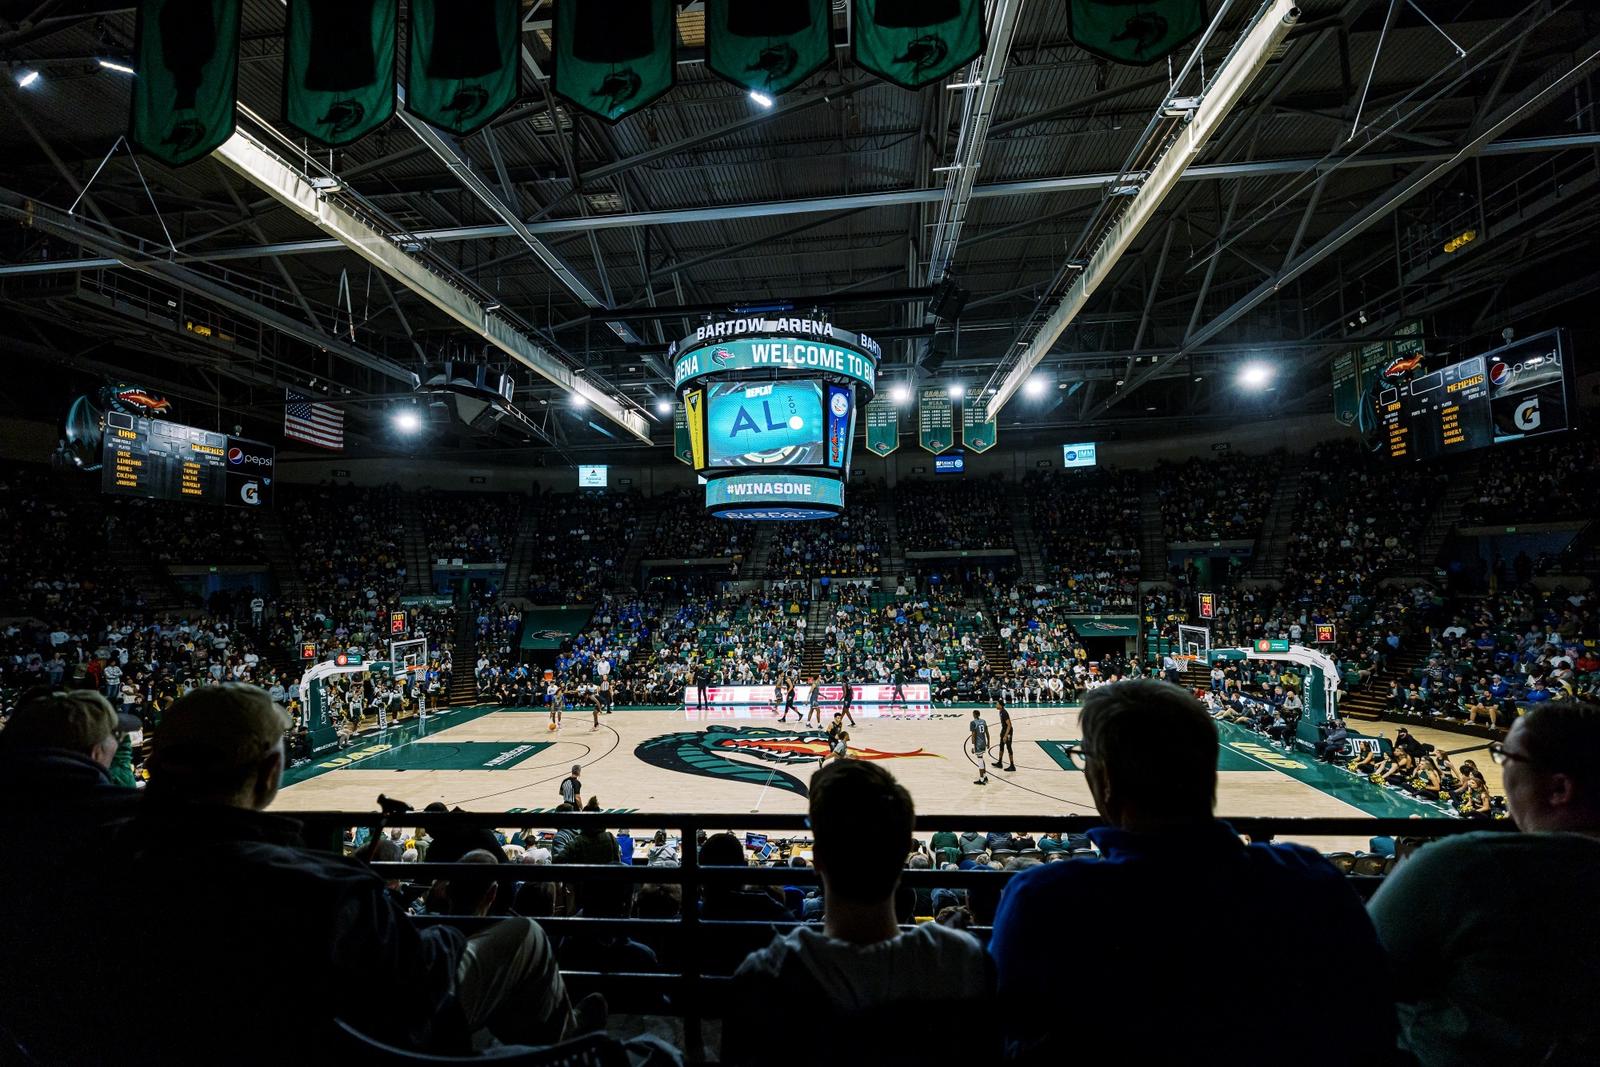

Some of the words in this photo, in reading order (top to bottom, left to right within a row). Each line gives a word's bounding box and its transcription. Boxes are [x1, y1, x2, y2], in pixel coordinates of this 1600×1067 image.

[697, 318, 764, 340] BARTOW
[776, 318, 834, 337] ARENA
[752, 343, 844, 371] WELCOME
[848, 354, 862, 377] TO
[1513, 349, 1561, 377] pepsi
[1447, 374, 1484, 393] MEMPHIS
[730, 400, 787, 438] AL
[1514, 398, 1541, 431] G
[118, 430, 137, 439] UAB
[191, 443, 224, 456] MEMPHIS
[244, 454, 272, 467] pepsi
[241, 482, 260, 504] G
[727, 483, 812, 495] #WINASONE
[317, 744, 392, 768] UAB
